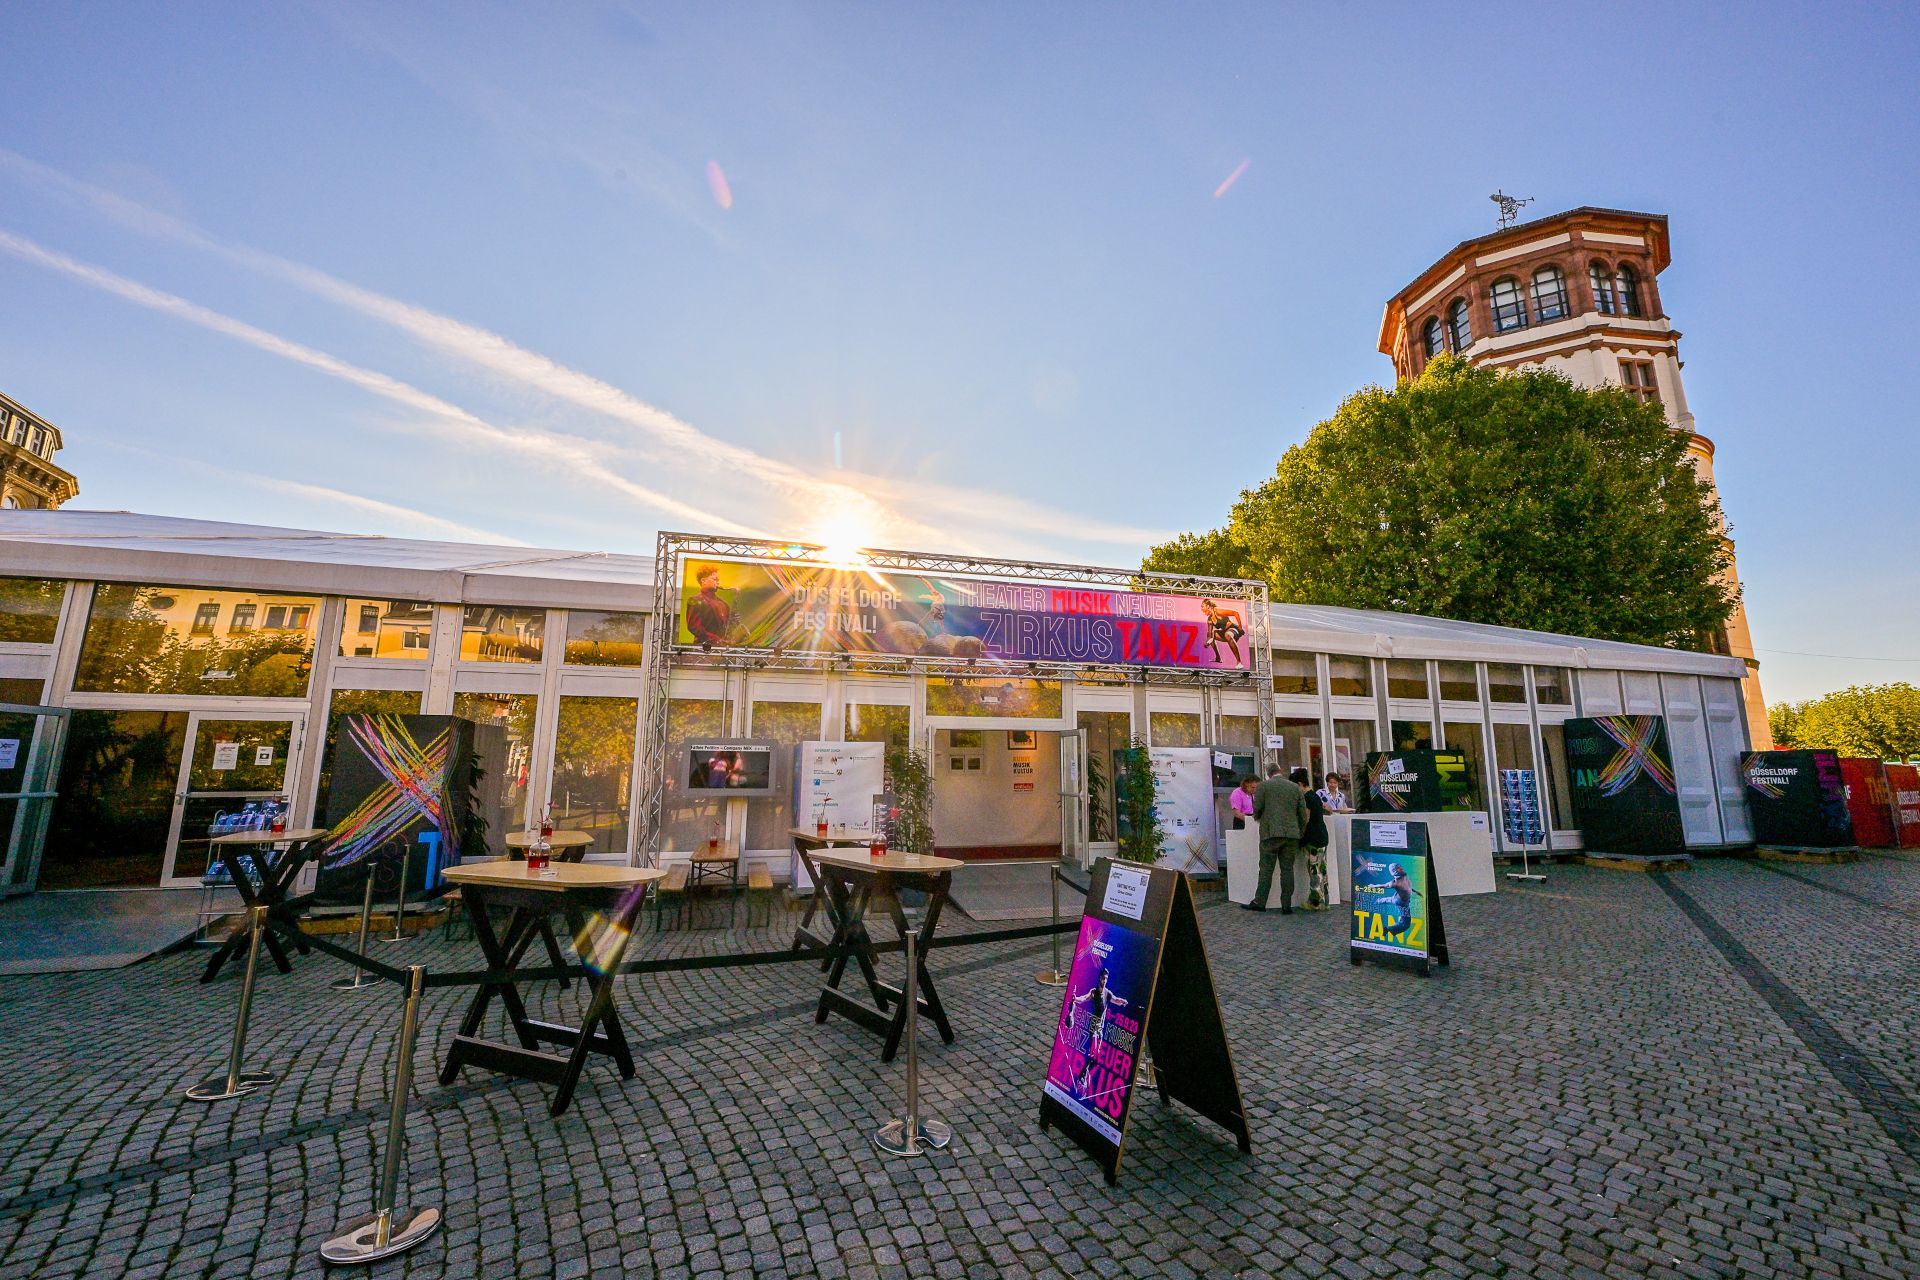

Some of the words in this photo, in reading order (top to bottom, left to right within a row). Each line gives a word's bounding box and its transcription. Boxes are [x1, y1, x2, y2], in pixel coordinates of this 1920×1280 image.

[794, 584, 902, 610] DÜSSELDORF
[957, 582, 1046, 612] THEATER
[1051, 588, 1112, 616] MUSIK
[1115, 593, 1176, 621] NEUER
[793, 611, 877, 634] FESTIVAL!
[980, 612, 1113, 659] ZIRKUS
[1115, 620, 1200, 664] TANZ
[1750, 766, 1799, 776] DÜSSELDORF
[1752, 776, 1790, 785] FESTIVAL!
[1381, 783, 1411, 793] FESTIVAL!
[1354, 910, 1424, 948] TANZ
